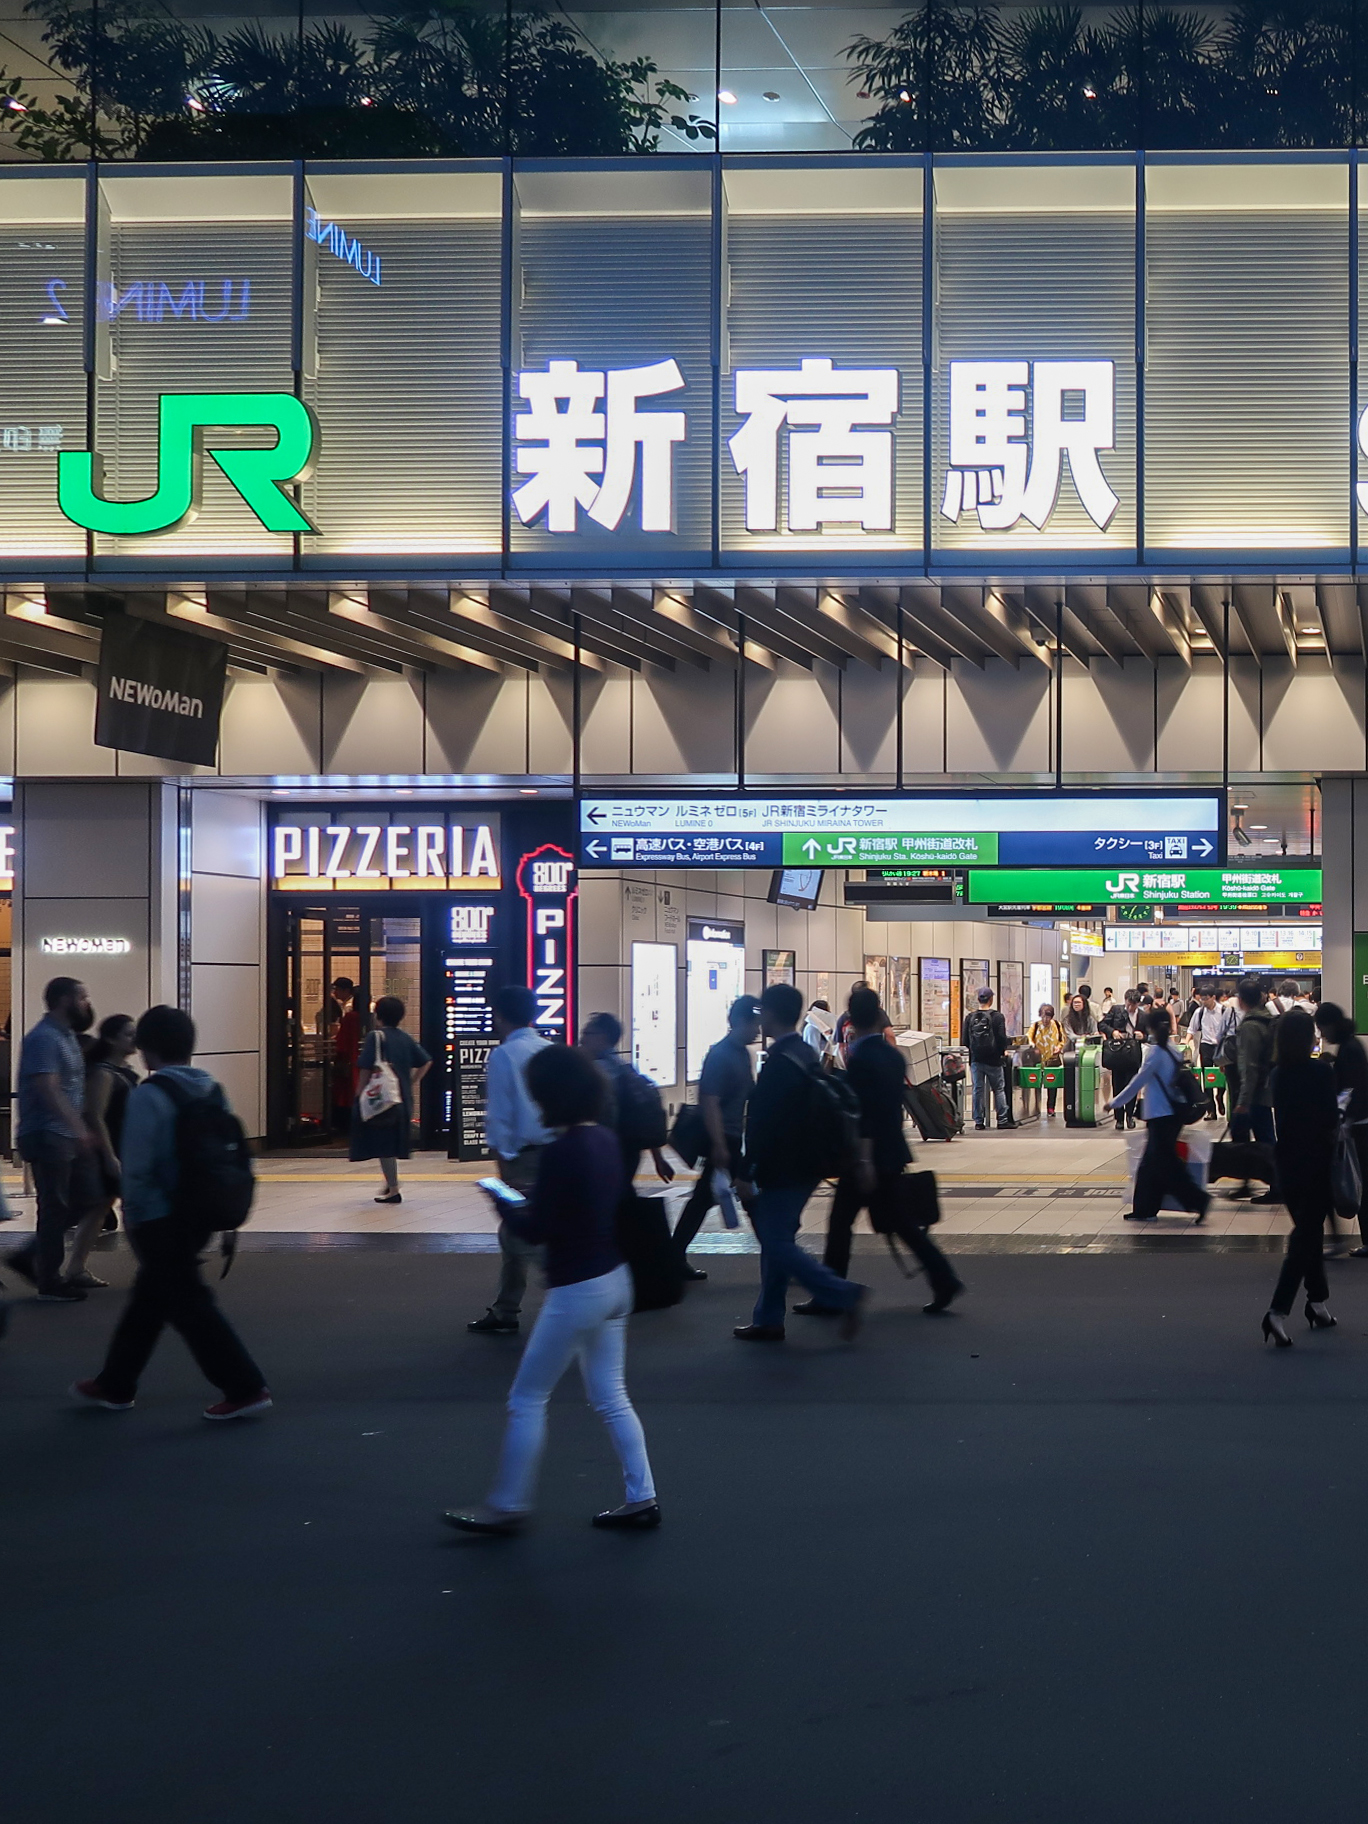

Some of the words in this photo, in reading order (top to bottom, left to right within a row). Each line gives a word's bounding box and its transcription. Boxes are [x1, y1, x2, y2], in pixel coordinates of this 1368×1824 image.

[511, 358, 1121, 533] 新宿駅
[57, 393, 318, 534] JR
[109, 676, 204, 719] NEWoMan
[612, 805, 669, 818] ニュウマン
[762, 805, 887, 818] JR新宿ミライナタワー
[675, 820, 706, 828] LUMINE
[827, 837, 857, 854] JR
[859, 837, 898, 851] 新宿駅
[902, 837, 978, 851] 甲州街道改札
[274, 826, 499, 878] PIZZERIA
[636, 853, 674, 863] Expressway
[692, 853, 714, 863] Airport
[715, 853, 741, 863] Express
[743, 853, 756, 861] Bus
[859, 853, 891, 862] Shinjuku
[894, 853, 908, 861] Sta.
[958, 853, 978, 861] Gate
[1105, 873, 1140, 892] JR
[1143, 873, 1186, 889] 新宿駅
[1221, 873, 1283, 885] 甲州街道改札
[1143, 890, 1179, 900] Shinjuku
[1181, 890, 1211, 899] Station
